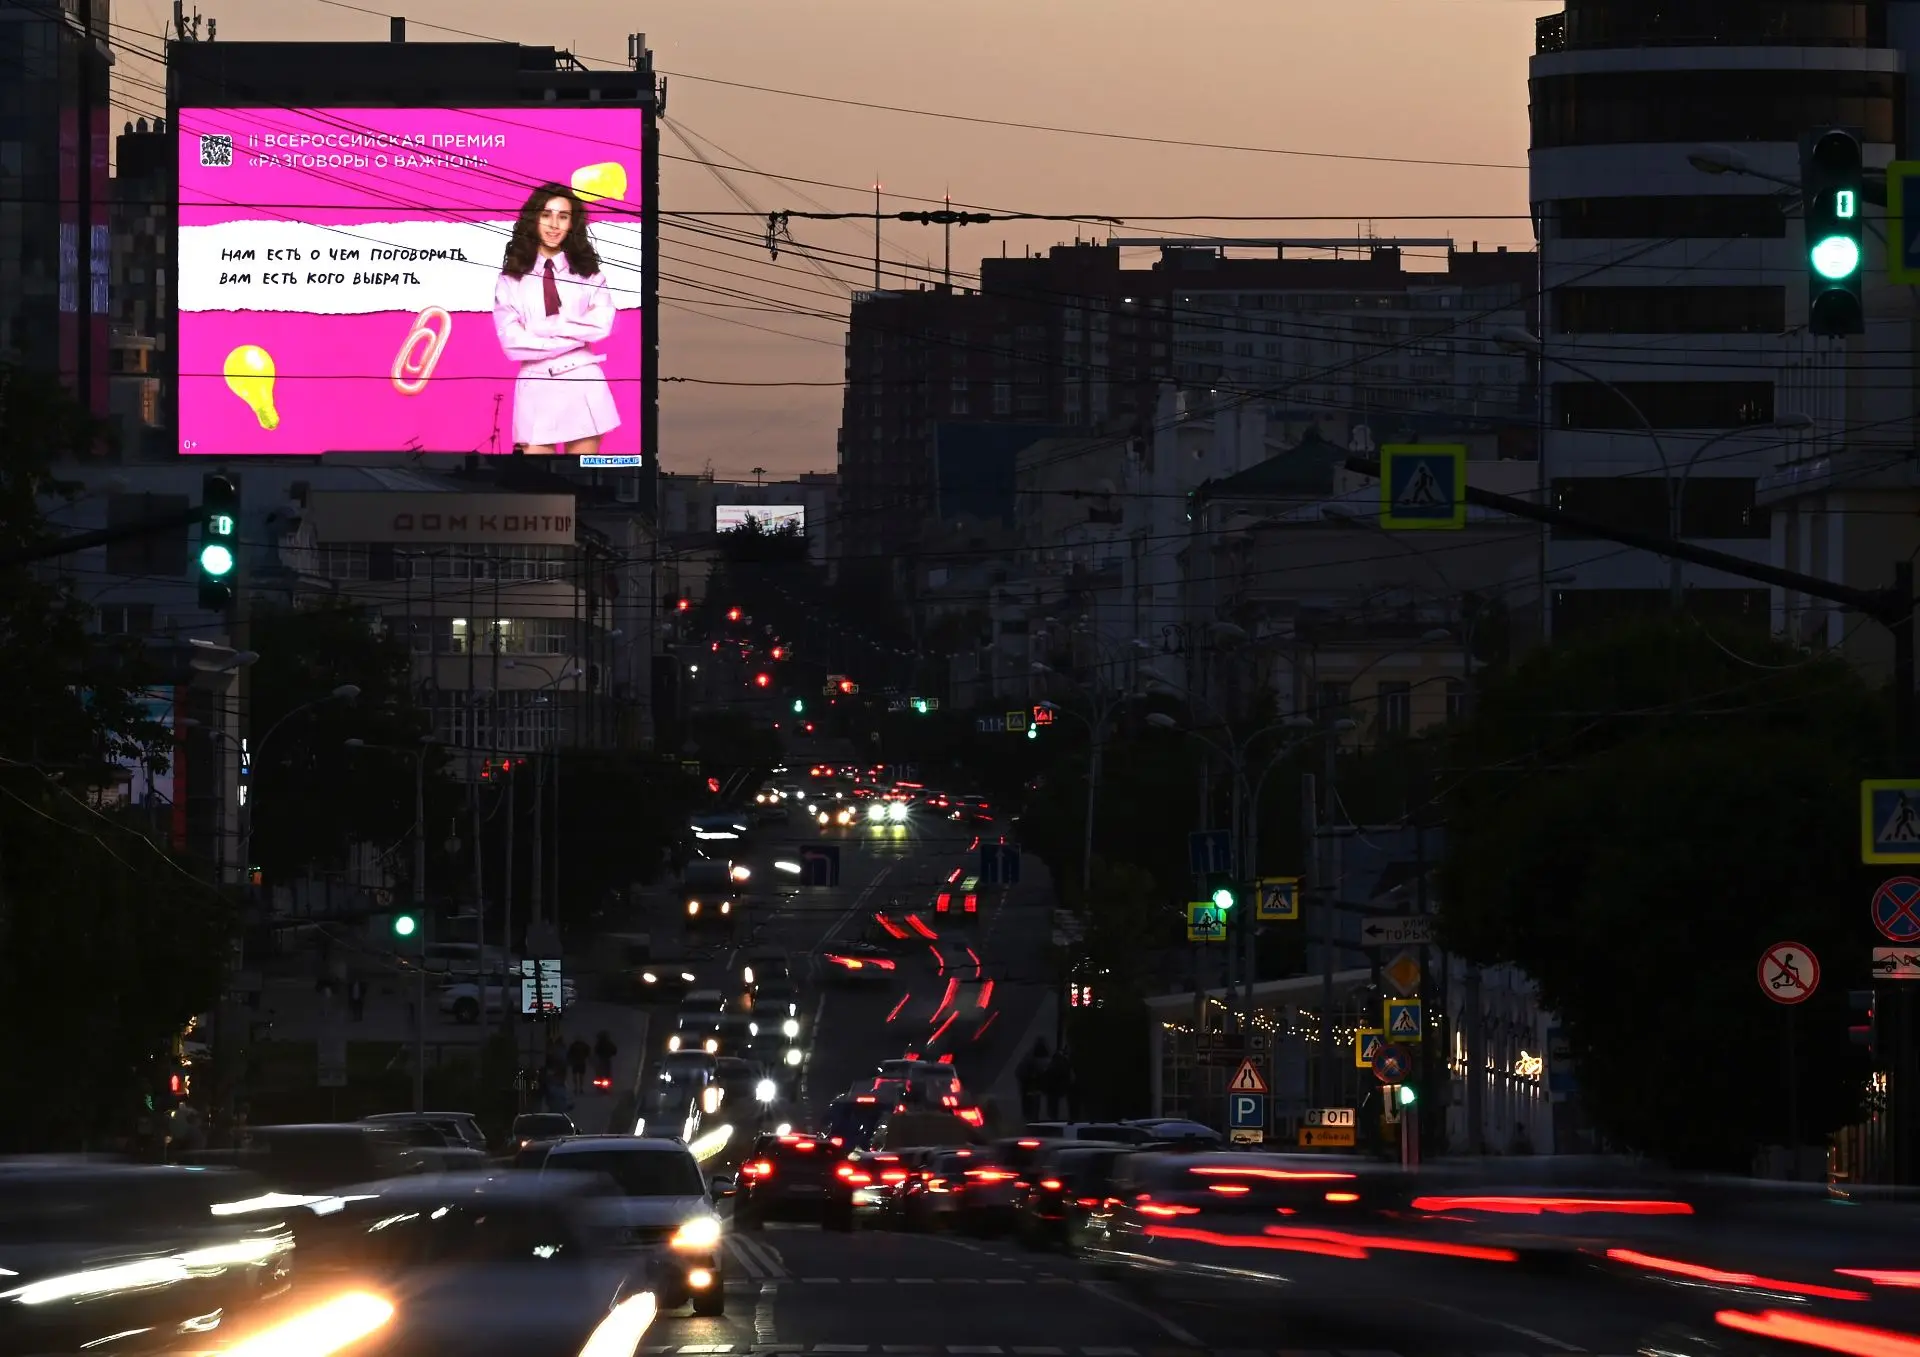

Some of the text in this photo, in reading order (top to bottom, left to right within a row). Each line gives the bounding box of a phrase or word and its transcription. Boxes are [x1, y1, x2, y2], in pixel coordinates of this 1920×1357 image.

[265, 131, 425, 148] ВСЕРОССИЙСКАЯ
[431, 134, 505, 148] ПРЕМИЯ
[249, 155, 488, 168] «РАЗГОВОРЫ О ВАЖНОМ»
[221, 249, 256, 261] НАМ
[267, 249, 301, 261] ЕСТЬ
[310, 249, 320, 261] О
[329, 249, 360, 261] ЧЕМ
[219, 273, 251, 285] ВАМ
[262, 273, 298, 285] ЕСТЬ
[306, 273, 345, 285] КОГО
[394, 514, 571, 533] ДОМ КОНТОР
[1308, 1110, 1350, 1124] СТОП
